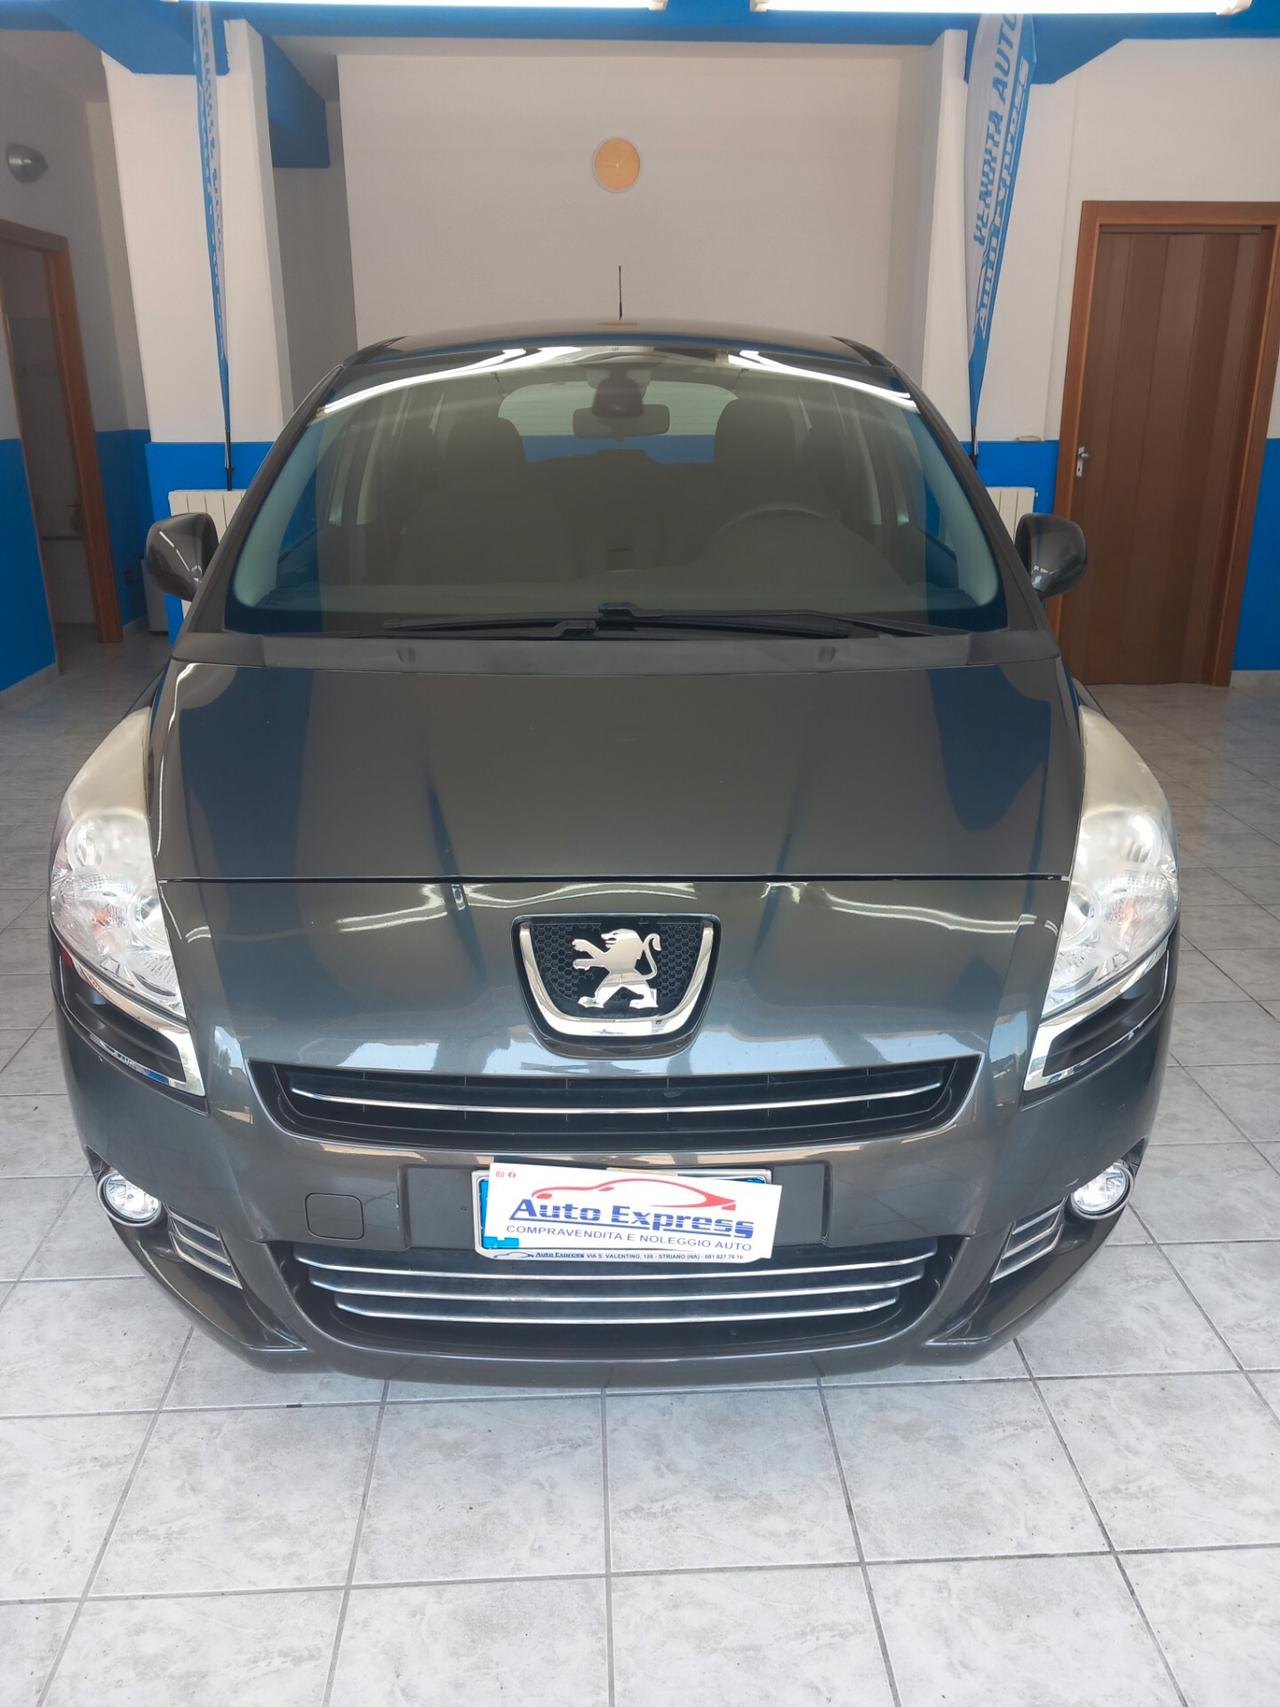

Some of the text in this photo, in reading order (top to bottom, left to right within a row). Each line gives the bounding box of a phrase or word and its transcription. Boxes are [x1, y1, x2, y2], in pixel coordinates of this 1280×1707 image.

[509, 1199, 754, 1239] Auto Express
[506, 1225, 752, 1251] COMPRAVENDITA E NOLEGGIO AUTO
